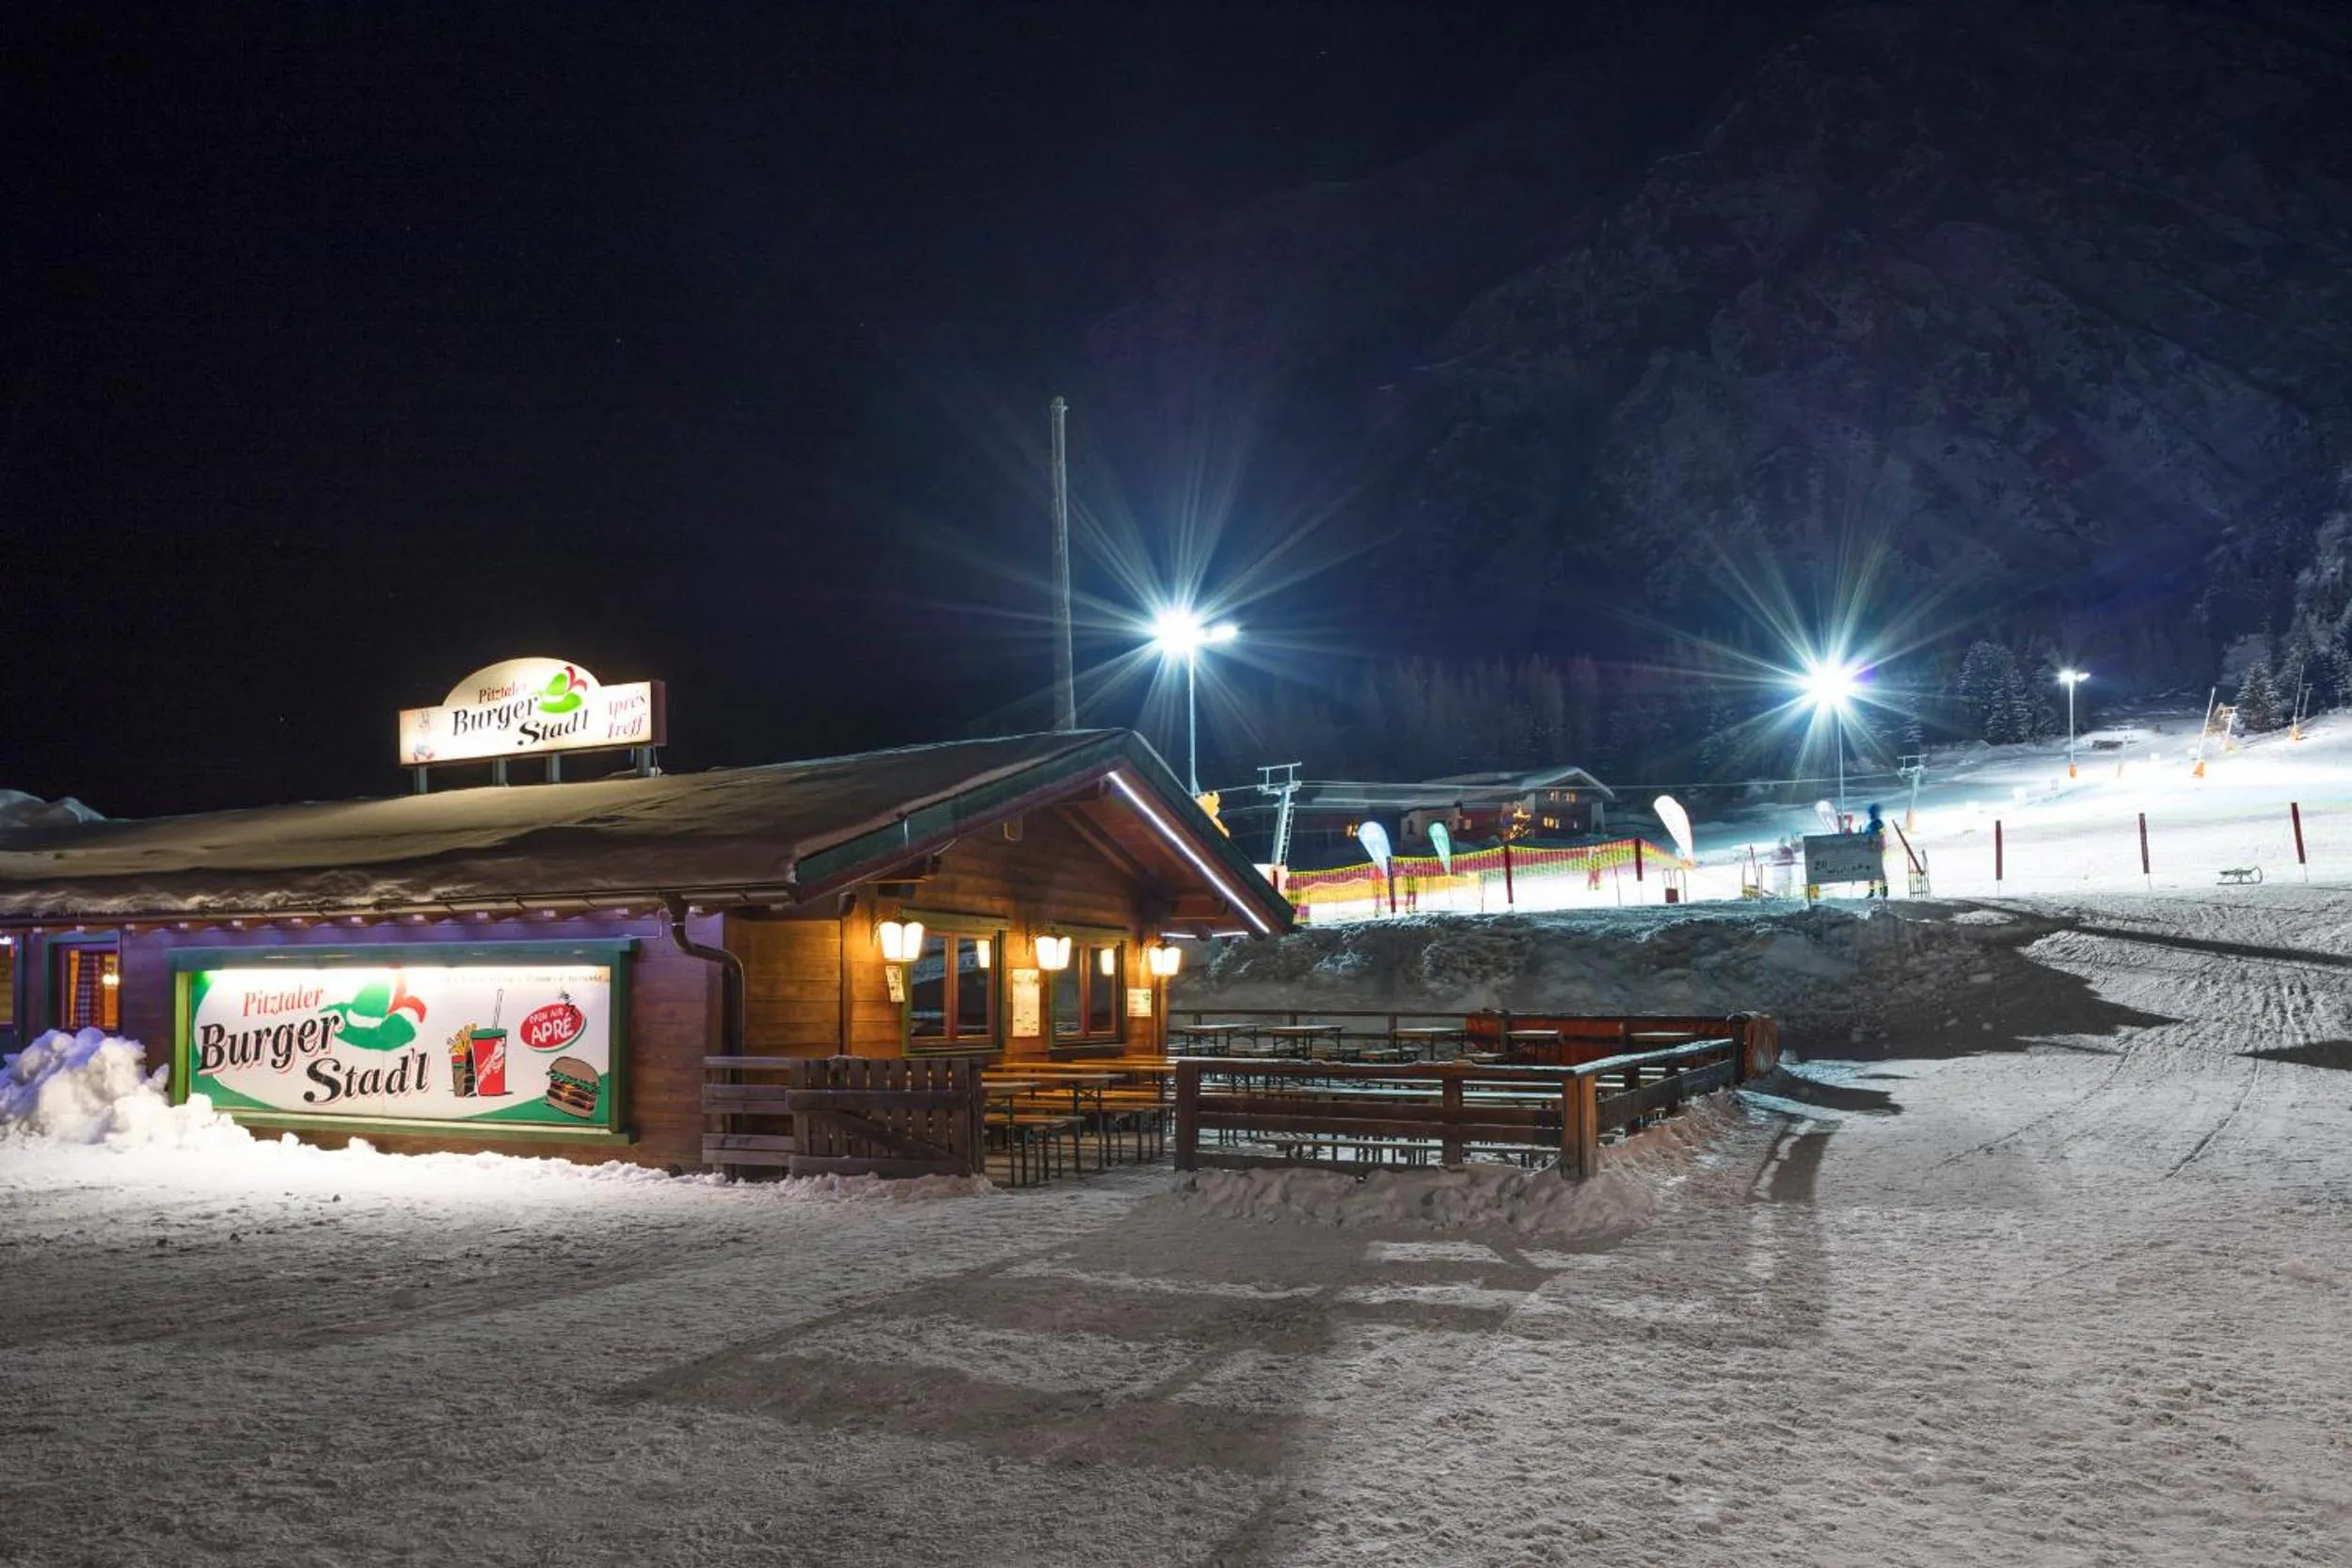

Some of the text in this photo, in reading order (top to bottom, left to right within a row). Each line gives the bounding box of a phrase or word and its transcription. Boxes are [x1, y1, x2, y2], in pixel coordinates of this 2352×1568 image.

[453, 696, 539, 736] Burger
[242, 984, 324, 1017] Pitztaler
[198, 1014, 342, 1073] Burger
